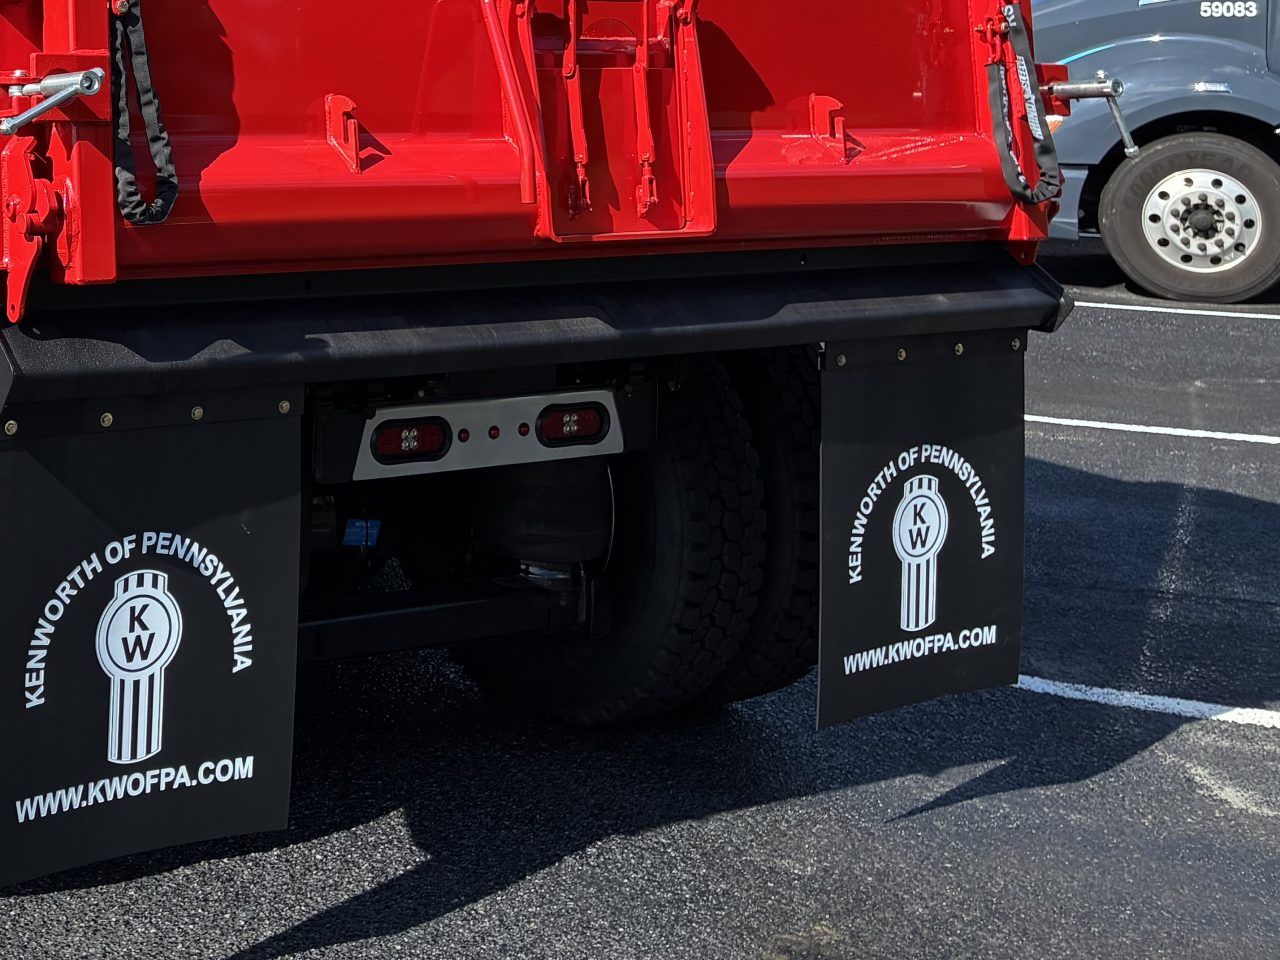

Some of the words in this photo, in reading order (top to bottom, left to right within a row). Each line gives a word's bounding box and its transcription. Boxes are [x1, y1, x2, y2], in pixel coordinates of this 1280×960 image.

[1200, 1, 1257, 18] 59083
[849, 461, 897, 584] KENWORTH
[898, 447, 919, 470] OF
[921, 444, 995, 559] PENNSYLVANIA
[913, 502, 927, 525] K
[908, 525, 931, 550] W
[25, 553, 103, 708] KENWORTH
[105, 534, 136, 564] OF
[142, 531, 253, 674] PENNSYLVANIA
[128, 603, 150, 633] K
[121, 632, 156, 664] W
[844, 625, 996, 675] WWW.KWOFPA.COM
[16, 756, 254, 824] WWW.KWOFPA.COM
